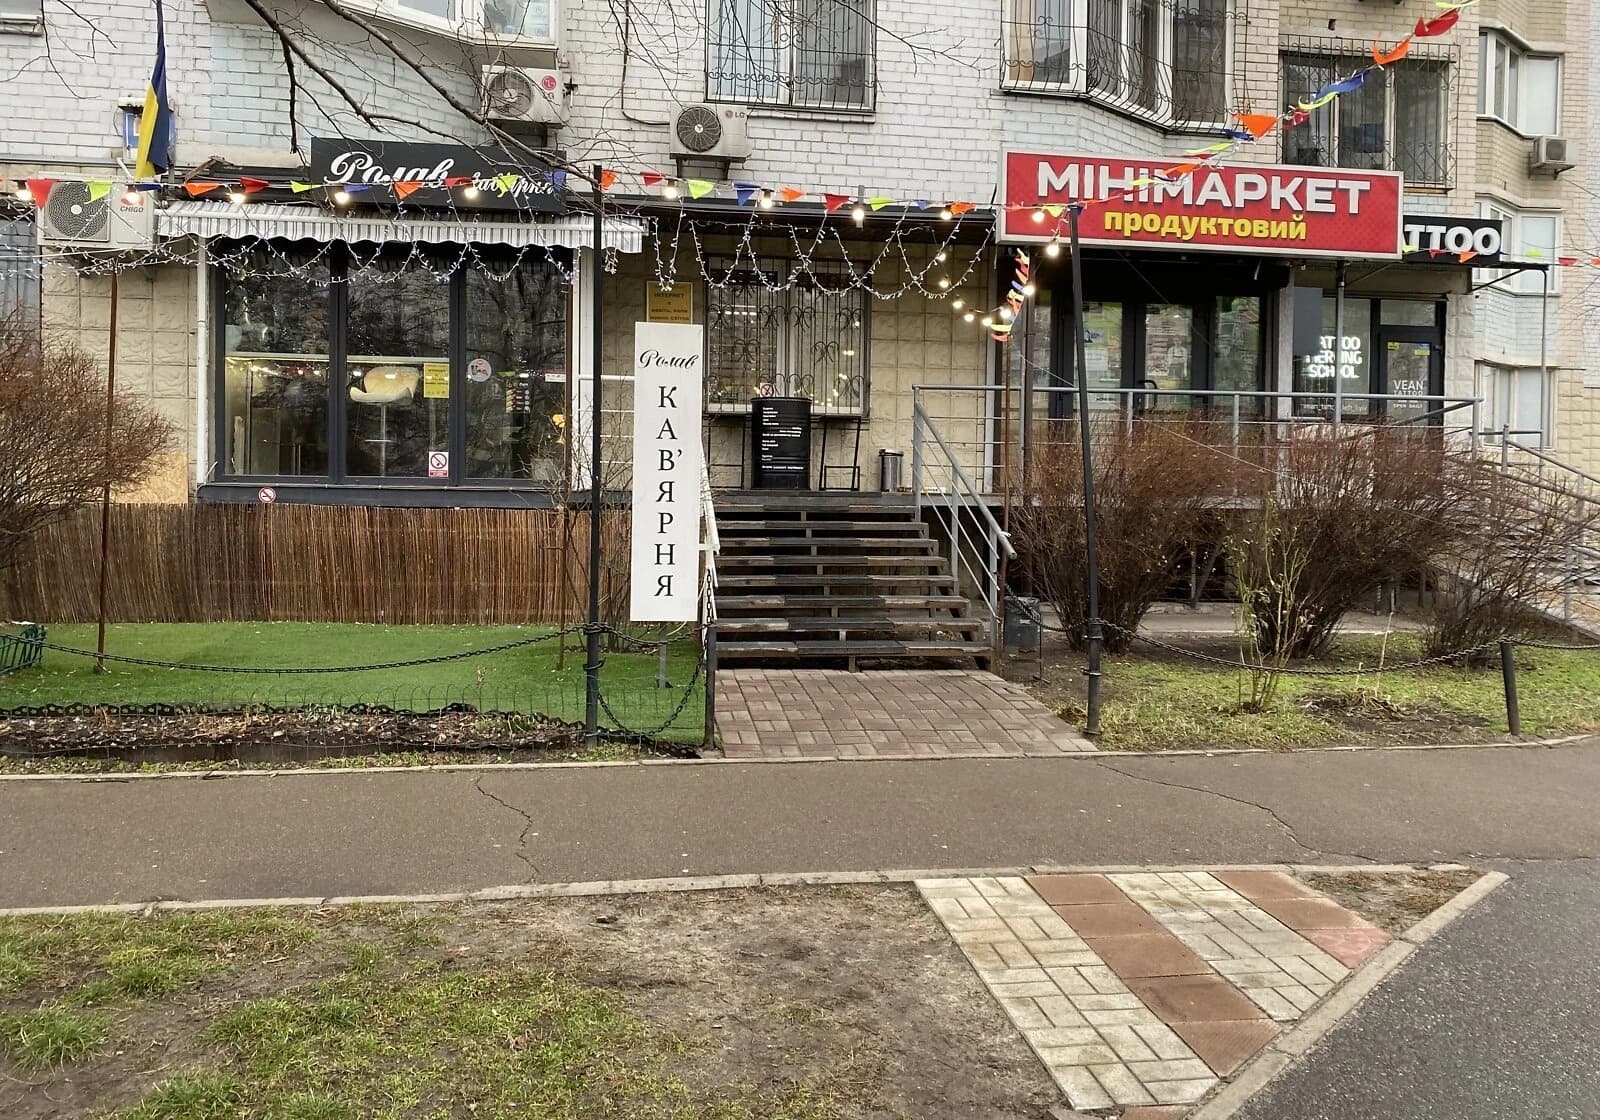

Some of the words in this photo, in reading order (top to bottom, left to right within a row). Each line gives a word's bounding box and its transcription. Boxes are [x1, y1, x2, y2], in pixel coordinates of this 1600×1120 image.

[1038, 161, 1371, 214] МІНІМАРКЕТ
[1104, 211, 1307, 240] продуктовий
[1402, 224, 1501, 256] TTOO
[639, 350, 700, 370] Ролав
[1308, 365, 1361, 379] SCHOL
[1393, 380, 1424, 391] VEAN
